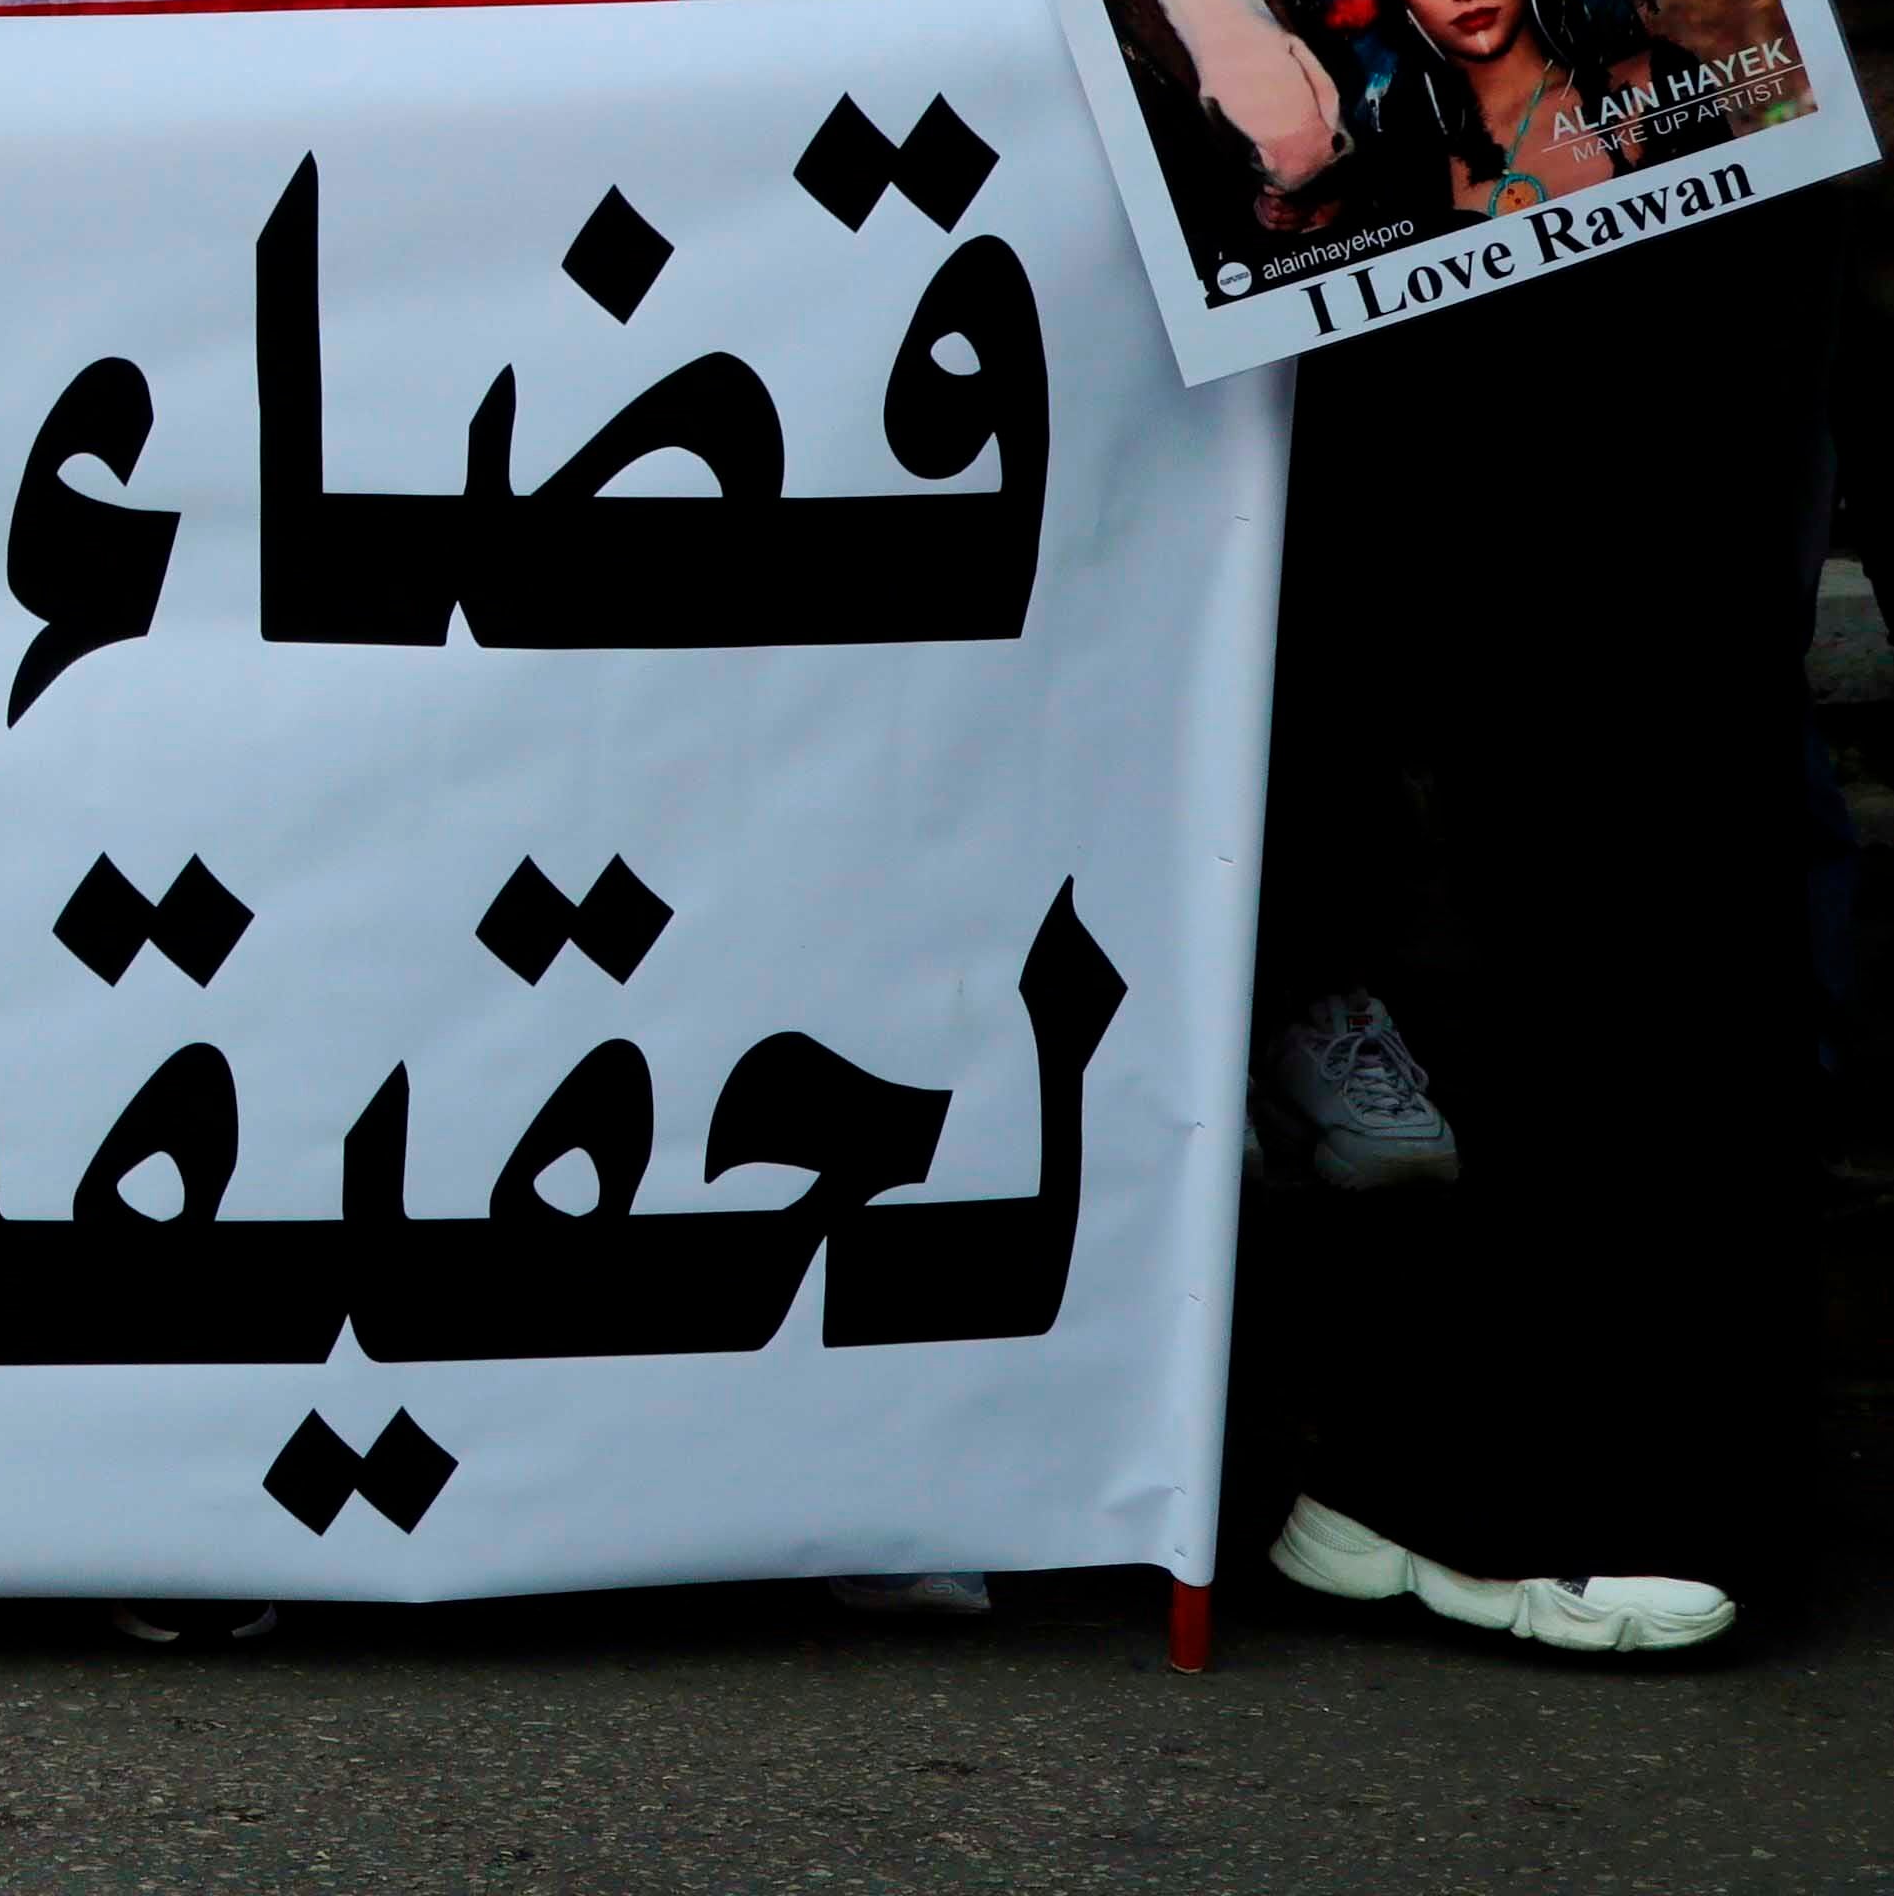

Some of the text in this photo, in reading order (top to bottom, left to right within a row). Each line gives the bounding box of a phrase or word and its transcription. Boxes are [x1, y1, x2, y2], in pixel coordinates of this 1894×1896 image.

[1553, 38, 1791, 140] ALAIN HAYEK
[1573, 78, 1786, 163] MAKE UP ARTIST
[1262, 217, 1414, 280] alainhayekpro
[1299, 162, 1755, 337] I Love Rawan
[7, 92, 1050, 729] قضاء
